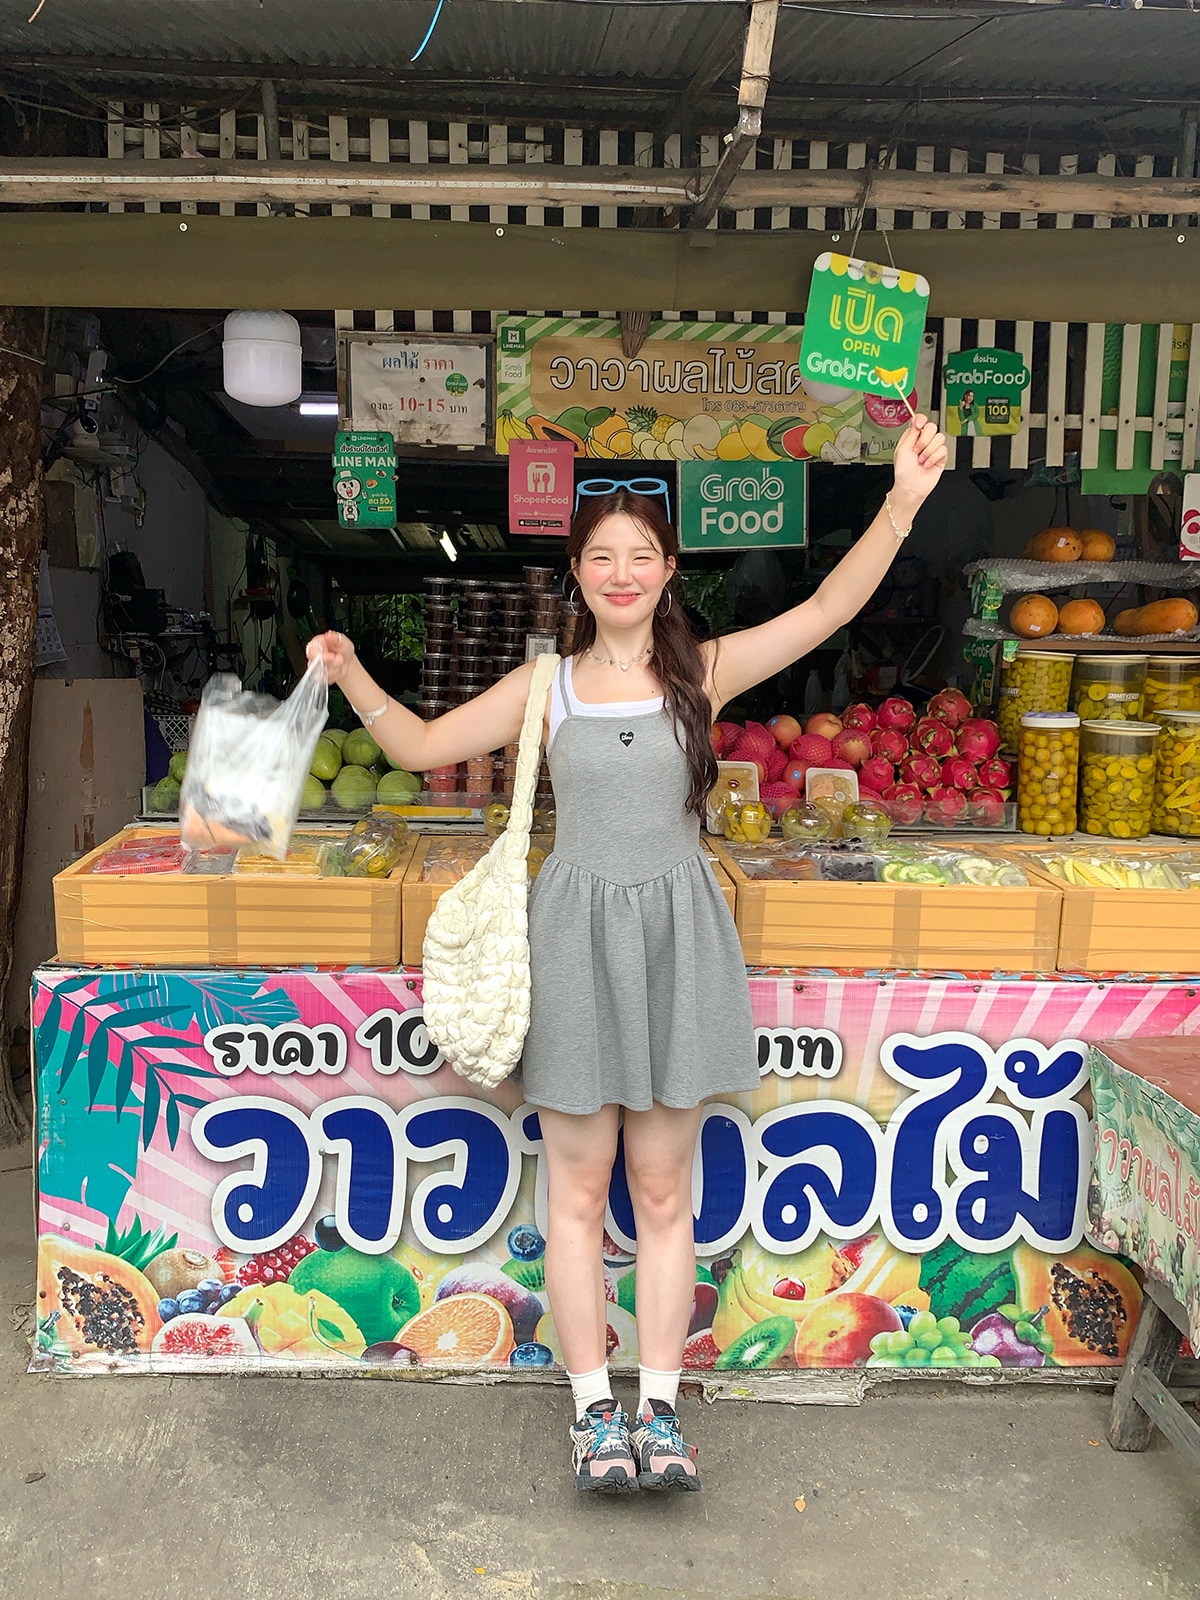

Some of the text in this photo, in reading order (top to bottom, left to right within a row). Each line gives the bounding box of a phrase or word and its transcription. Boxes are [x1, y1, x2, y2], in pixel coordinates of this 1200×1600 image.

[829, 286, 904, 344] เปิด
[843, 337, 880, 358] OPEN
[382, 350, 455, 371] ผลไม้ ราคา
[505, 371, 523, 379] Food
[945, 368, 1027, 385] GrabFood
[399, 396, 445, 413] 10-15
[449, 404, 468, 414] บาท
[724, 399, 807, 414] 083-5736679
[333, 456, 396, 467] LINE MAN
[700, 467, 785, 503] Grab
[513, 493, 569, 506] ShopeeFood
[701, 502, 784, 535] Food
[212, 1030, 338, 1068] ราคา
[1094, 1121, 1200, 1243] าวาผลไม้
